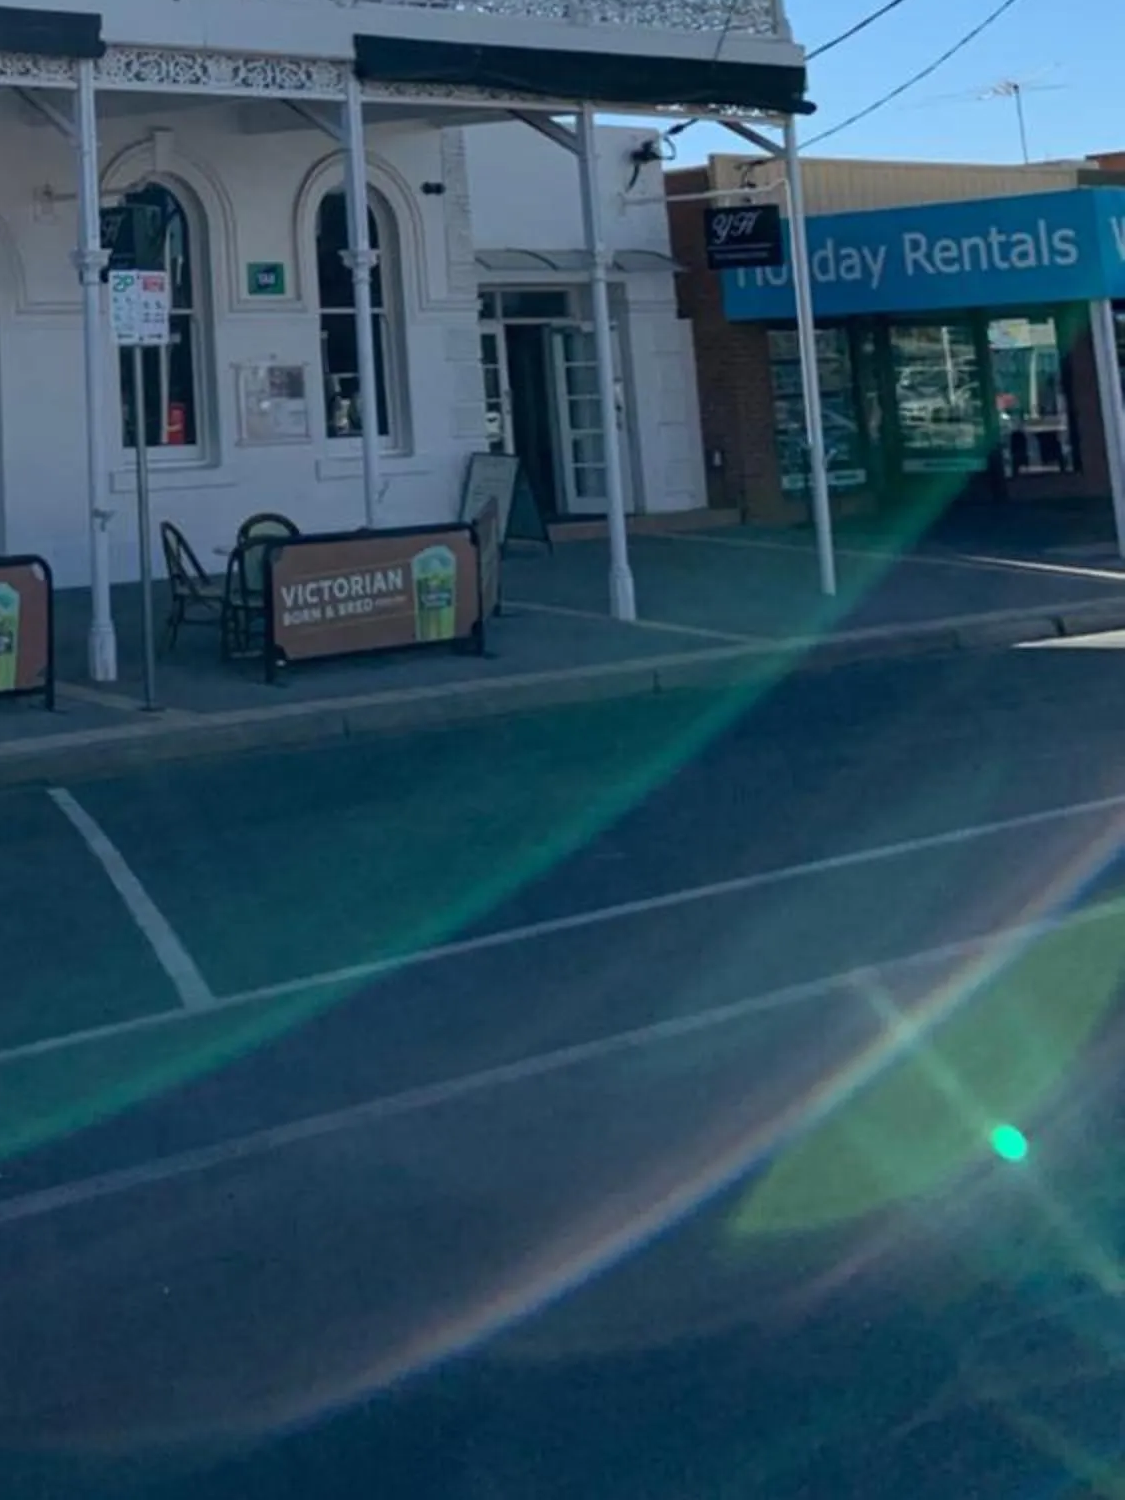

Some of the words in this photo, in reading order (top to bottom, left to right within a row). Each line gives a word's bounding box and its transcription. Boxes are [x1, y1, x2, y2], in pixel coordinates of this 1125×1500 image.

[903, 218, 1078, 276] Rentals
[112, 275, 135, 293] 2P
[281, 568, 404, 607] VICTORIAN
[283, 607, 322, 626] BORN
